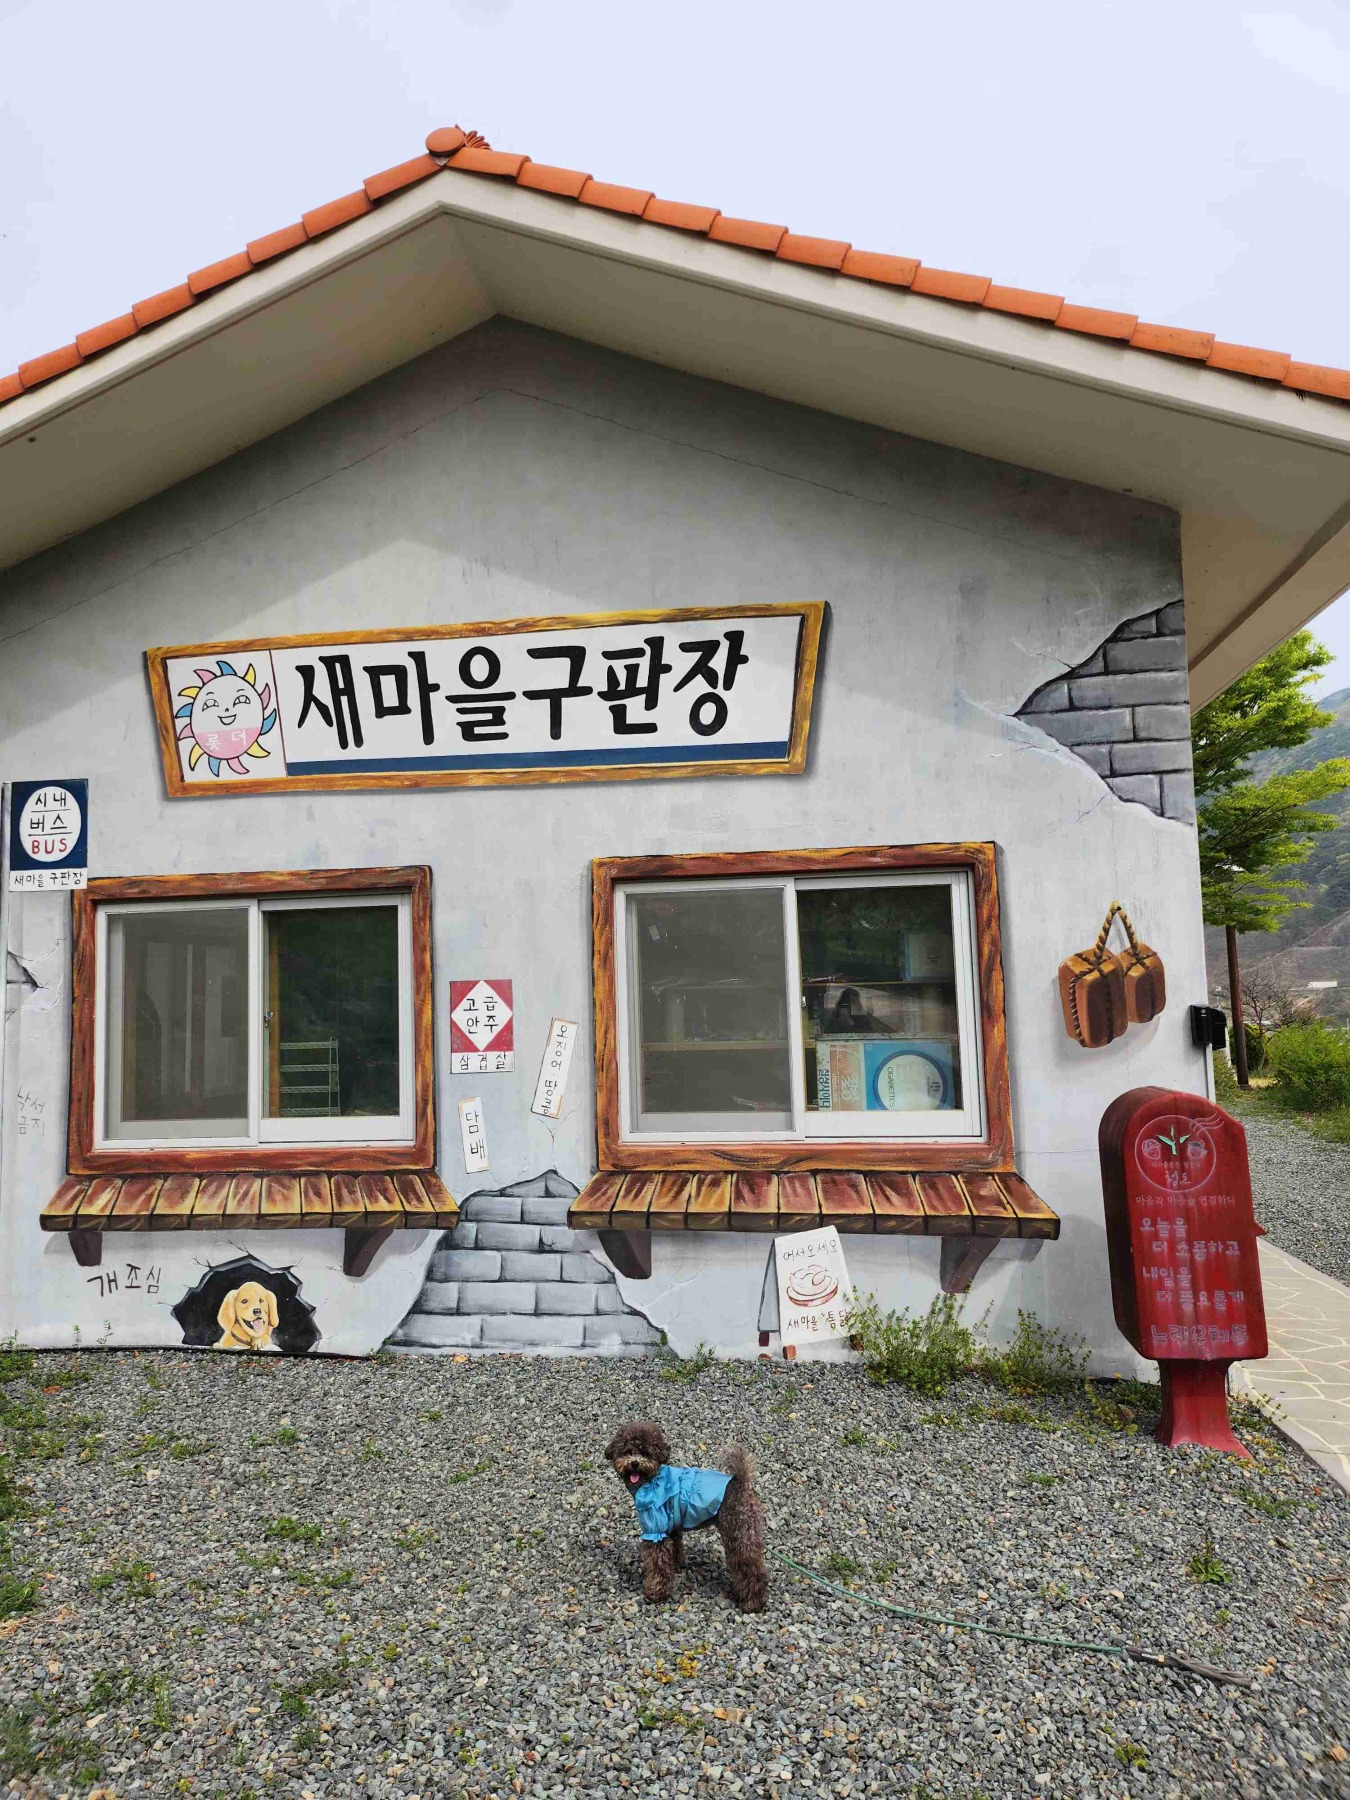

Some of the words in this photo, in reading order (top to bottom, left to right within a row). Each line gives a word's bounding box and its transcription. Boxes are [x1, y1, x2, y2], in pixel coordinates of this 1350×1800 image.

[295, 630, 749, 749] 새마을구판장
[35, 791, 67, 807] 시내
[30, 813, 68, 832] 버스
[31, 838, 68, 855] BUS
[14, 874, 44, 888] 새마을
[49, 871, 84, 886] 구판장
[463, 996, 498, 1011] 고급
[466, 1015, 499, 1034] 안주
[459, 1051, 507, 1071] 삼겹살
[818, 1068, 831, 1109] 칠성사이다
[17, 1086, 45, 1112] 낙서
[18, 1115, 45, 1136] 금지
[465, 1110, 486, 1160] 담배
[1140, 1217, 1188, 1237] 오늘을
[1152, 1240, 1168, 1254] 더
[1176, 1240, 1240, 1261] 소중하고
[87, 1264, 161, 1297] 개조심
[1142, 1266, 1191, 1287] 내일을
[1156, 1290, 1172, 1304] 더
[787, 1315, 819, 1332] 새마을
